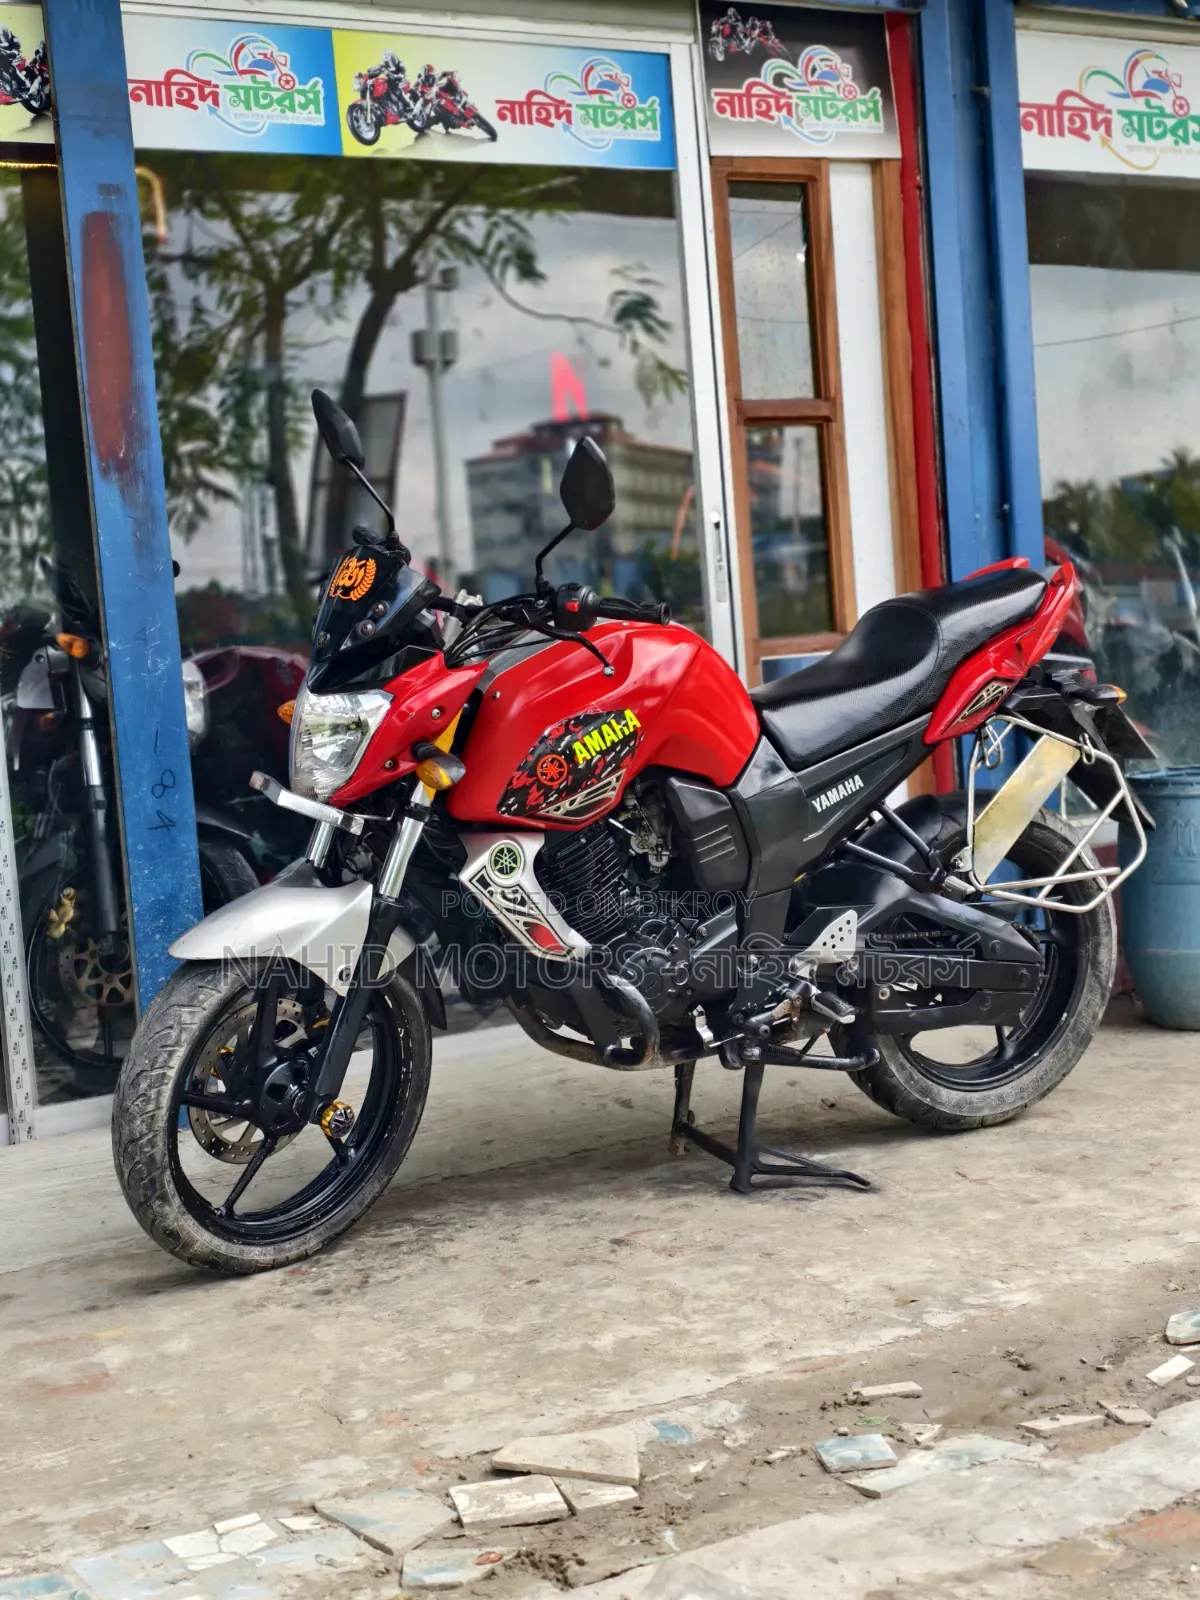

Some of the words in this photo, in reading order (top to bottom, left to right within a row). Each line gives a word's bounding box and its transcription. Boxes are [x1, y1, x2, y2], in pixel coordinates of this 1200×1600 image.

[127, 69, 220, 111] নাহিদ
[495, 89, 573, 128] নাহিদ
[713, 80, 794, 122] নাহিদ
[1019, 89, 1113, 142] নাহিদ
[811, 774, 864, 813] YAMAHA
